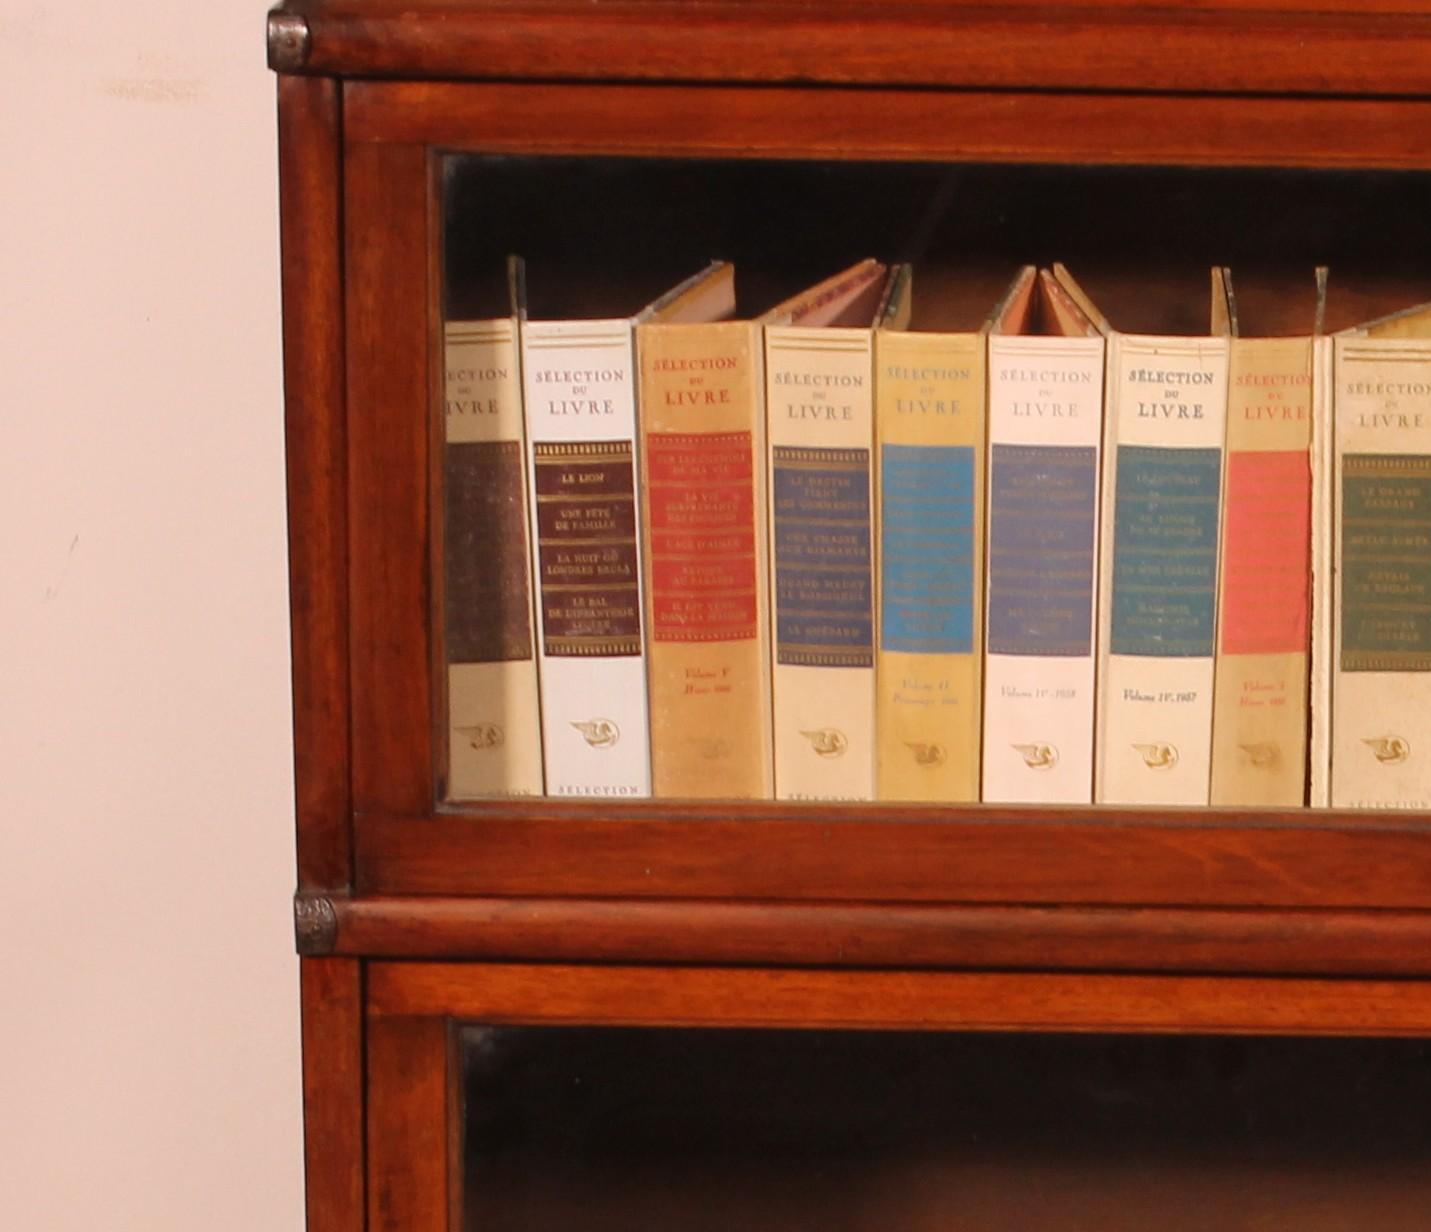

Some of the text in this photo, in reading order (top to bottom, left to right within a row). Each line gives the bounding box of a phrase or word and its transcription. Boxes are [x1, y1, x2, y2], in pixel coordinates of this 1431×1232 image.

[653, 357, 737, 371] SÉLECTION
[535, 368, 624, 383] SÉLECTION
[775, 371, 863, 386] SÉLECTION
[887, 367, 971, 380] SÉLECTION
[1000, 370, 1092, 383] SÉLECTION
[1129, 369, 1214, 384] SÉLECTION
[573, 386, 587, 395] DU
[665, 389, 730, 406] LIVRE
[1165, 390, 1179, 399] DU
[447, 400, 498, 415] IVRE
[550, 400, 615, 415] LIVRE
[788, 404, 853, 420] LIVRE
[897, 400, 961, 415] LIVRE
[1013, 402, 1080, 417] LIVRE
[1138, 403, 1204, 419] LIVRE
[1244, 406, 1306, 421] LIVRE
[1359, 413, 1425, 428] LIVRE
[562, 472, 605, 484] LE LION
[1123, 688, 1155, 702] Volume
